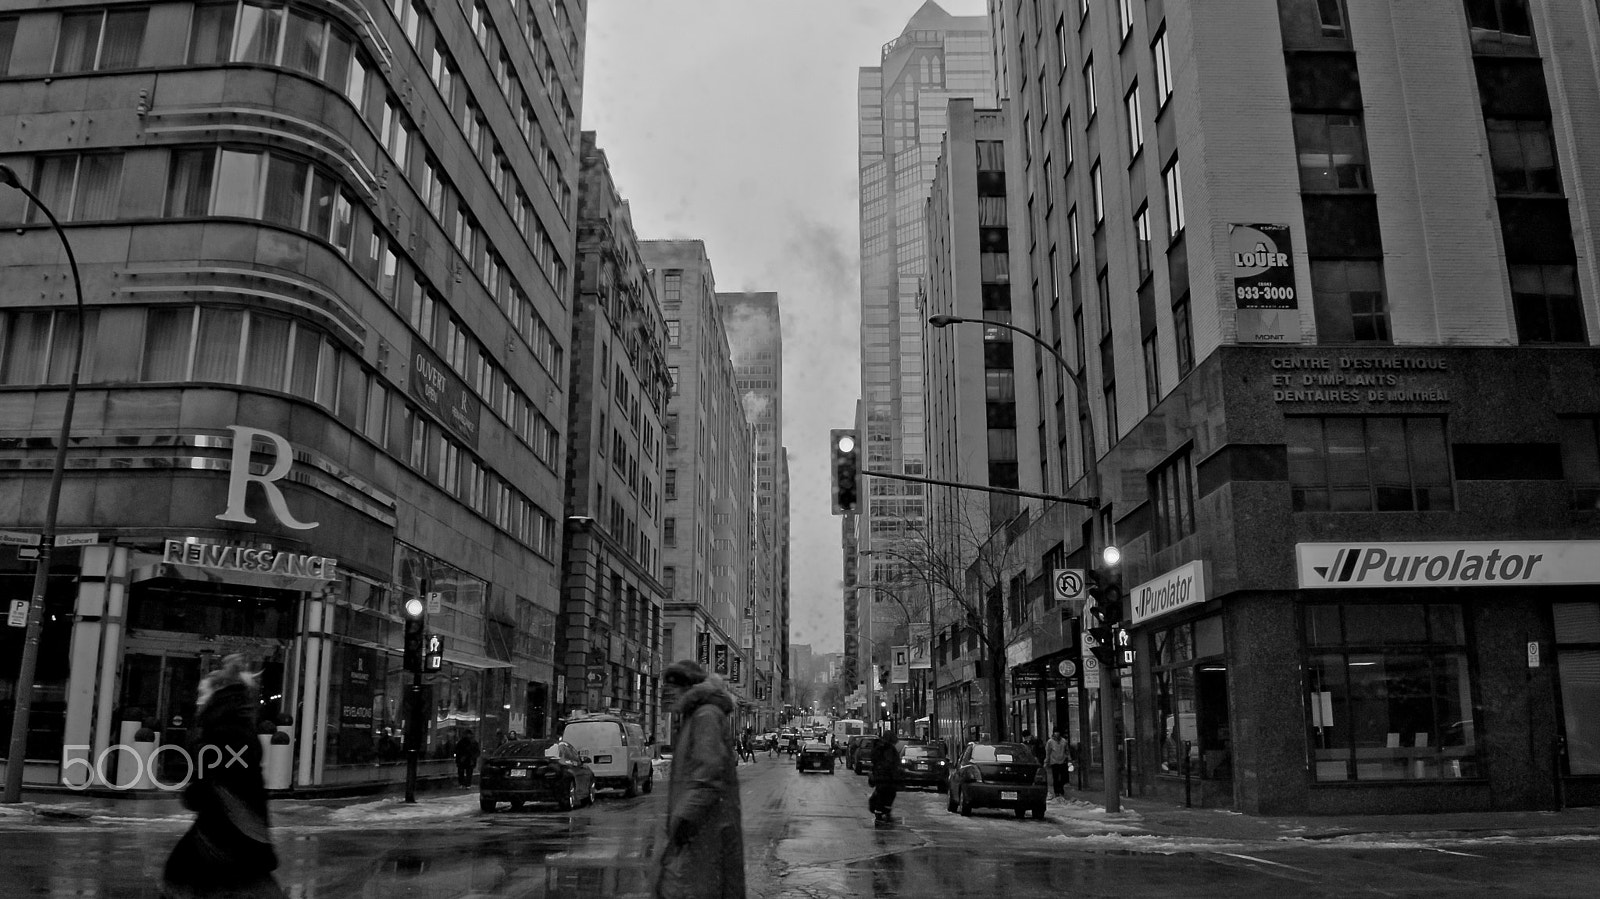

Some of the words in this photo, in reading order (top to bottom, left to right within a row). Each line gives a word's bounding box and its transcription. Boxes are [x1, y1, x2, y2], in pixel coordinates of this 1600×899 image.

[1234, 252, 1289, 267] LOUER
[1237, 286, 1294, 300] 933-3000
[1271, 357, 1330, 370] CENTRE
[416, 353, 447, 393] OUVERT
[1271, 374, 1291, 386] ET
[1303, 373, 1397, 386] D'IMPLANTS
[425, 383, 438, 404] OPEN
[1273, 390, 1360, 403] DENTAIRES
[1368, 391, 1384, 402] DE
[461, 390, 467, 414] R
[215, 425, 320, 530] R
[66, 537, 93, 545] Cathcart
[163, 539, 338, 581] RENAISSANCE
[1356, 546, 1543, 583] Purolator
[431, 593, 438, 601] P
[1144, 568, 1194, 618] Purolator
[16, 601, 24, 611] P
